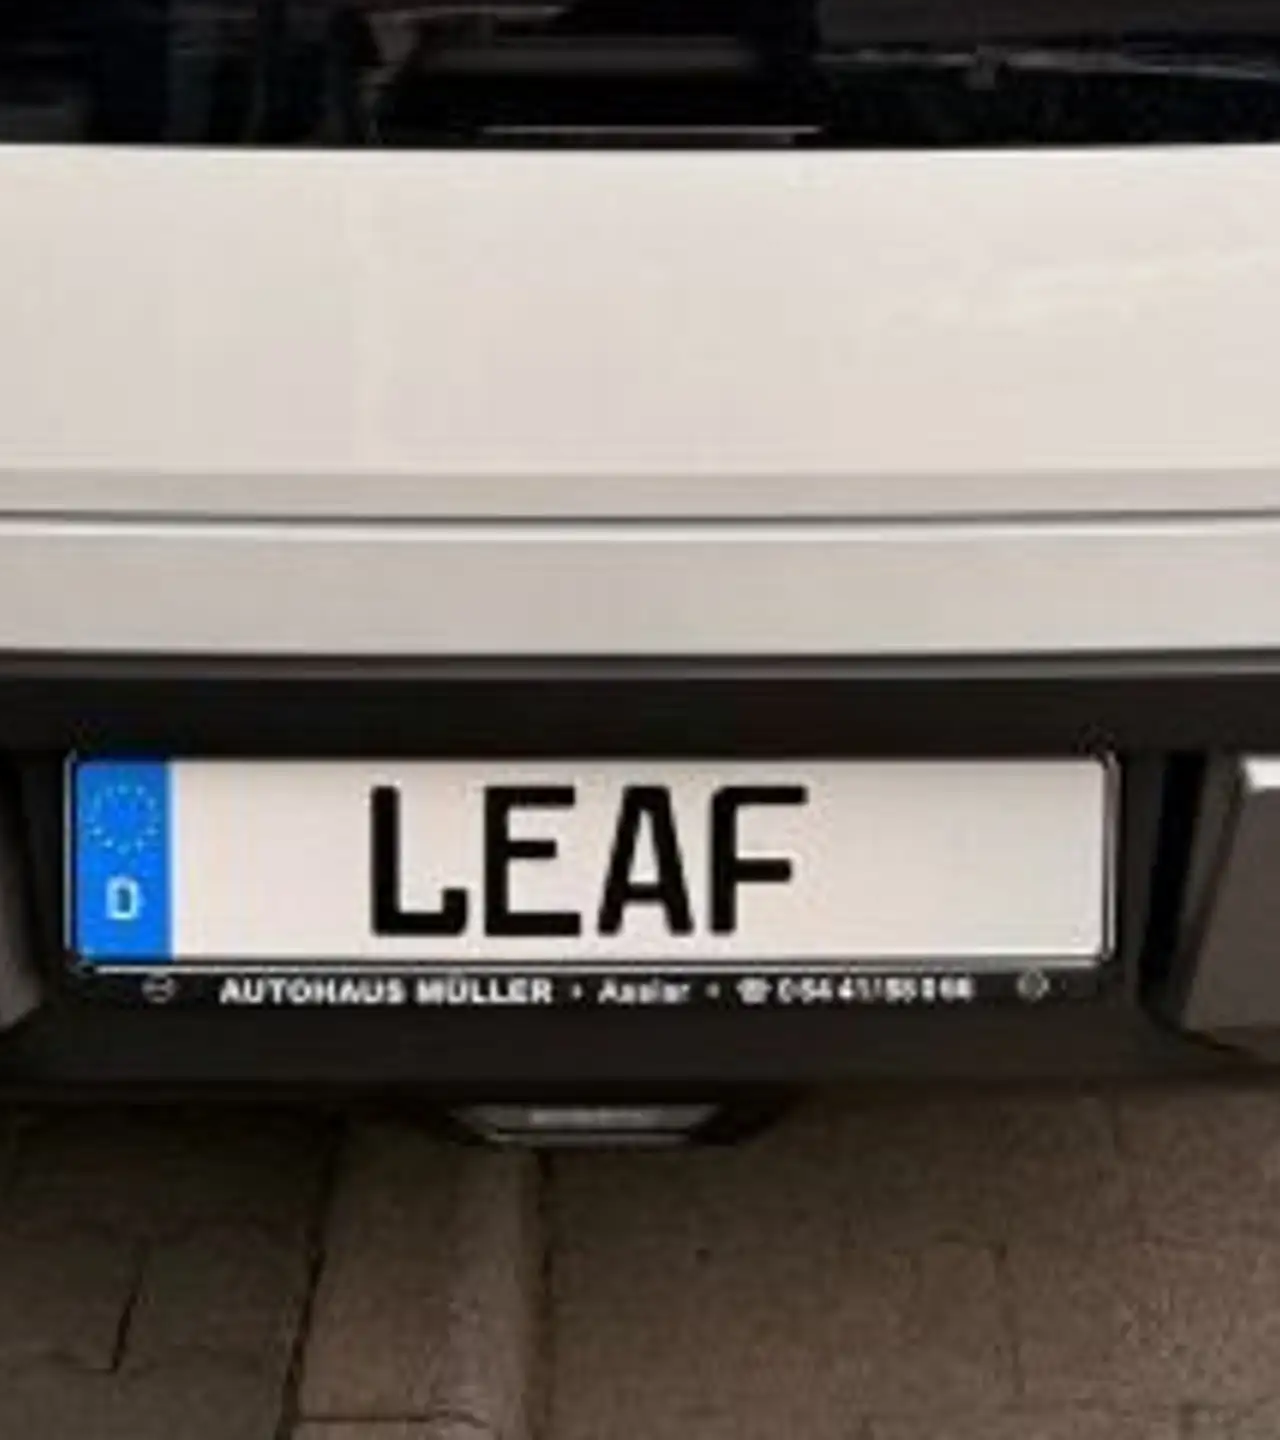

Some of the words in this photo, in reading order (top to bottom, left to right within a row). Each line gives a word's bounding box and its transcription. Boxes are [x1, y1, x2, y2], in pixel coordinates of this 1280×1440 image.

[370, 785, 808, 937] LEAF
[106, 876, 142, 921] D
[220, 977, 406, 1004] AUTOHAUS
[416, 973, 554, 1004] MÜLLER
